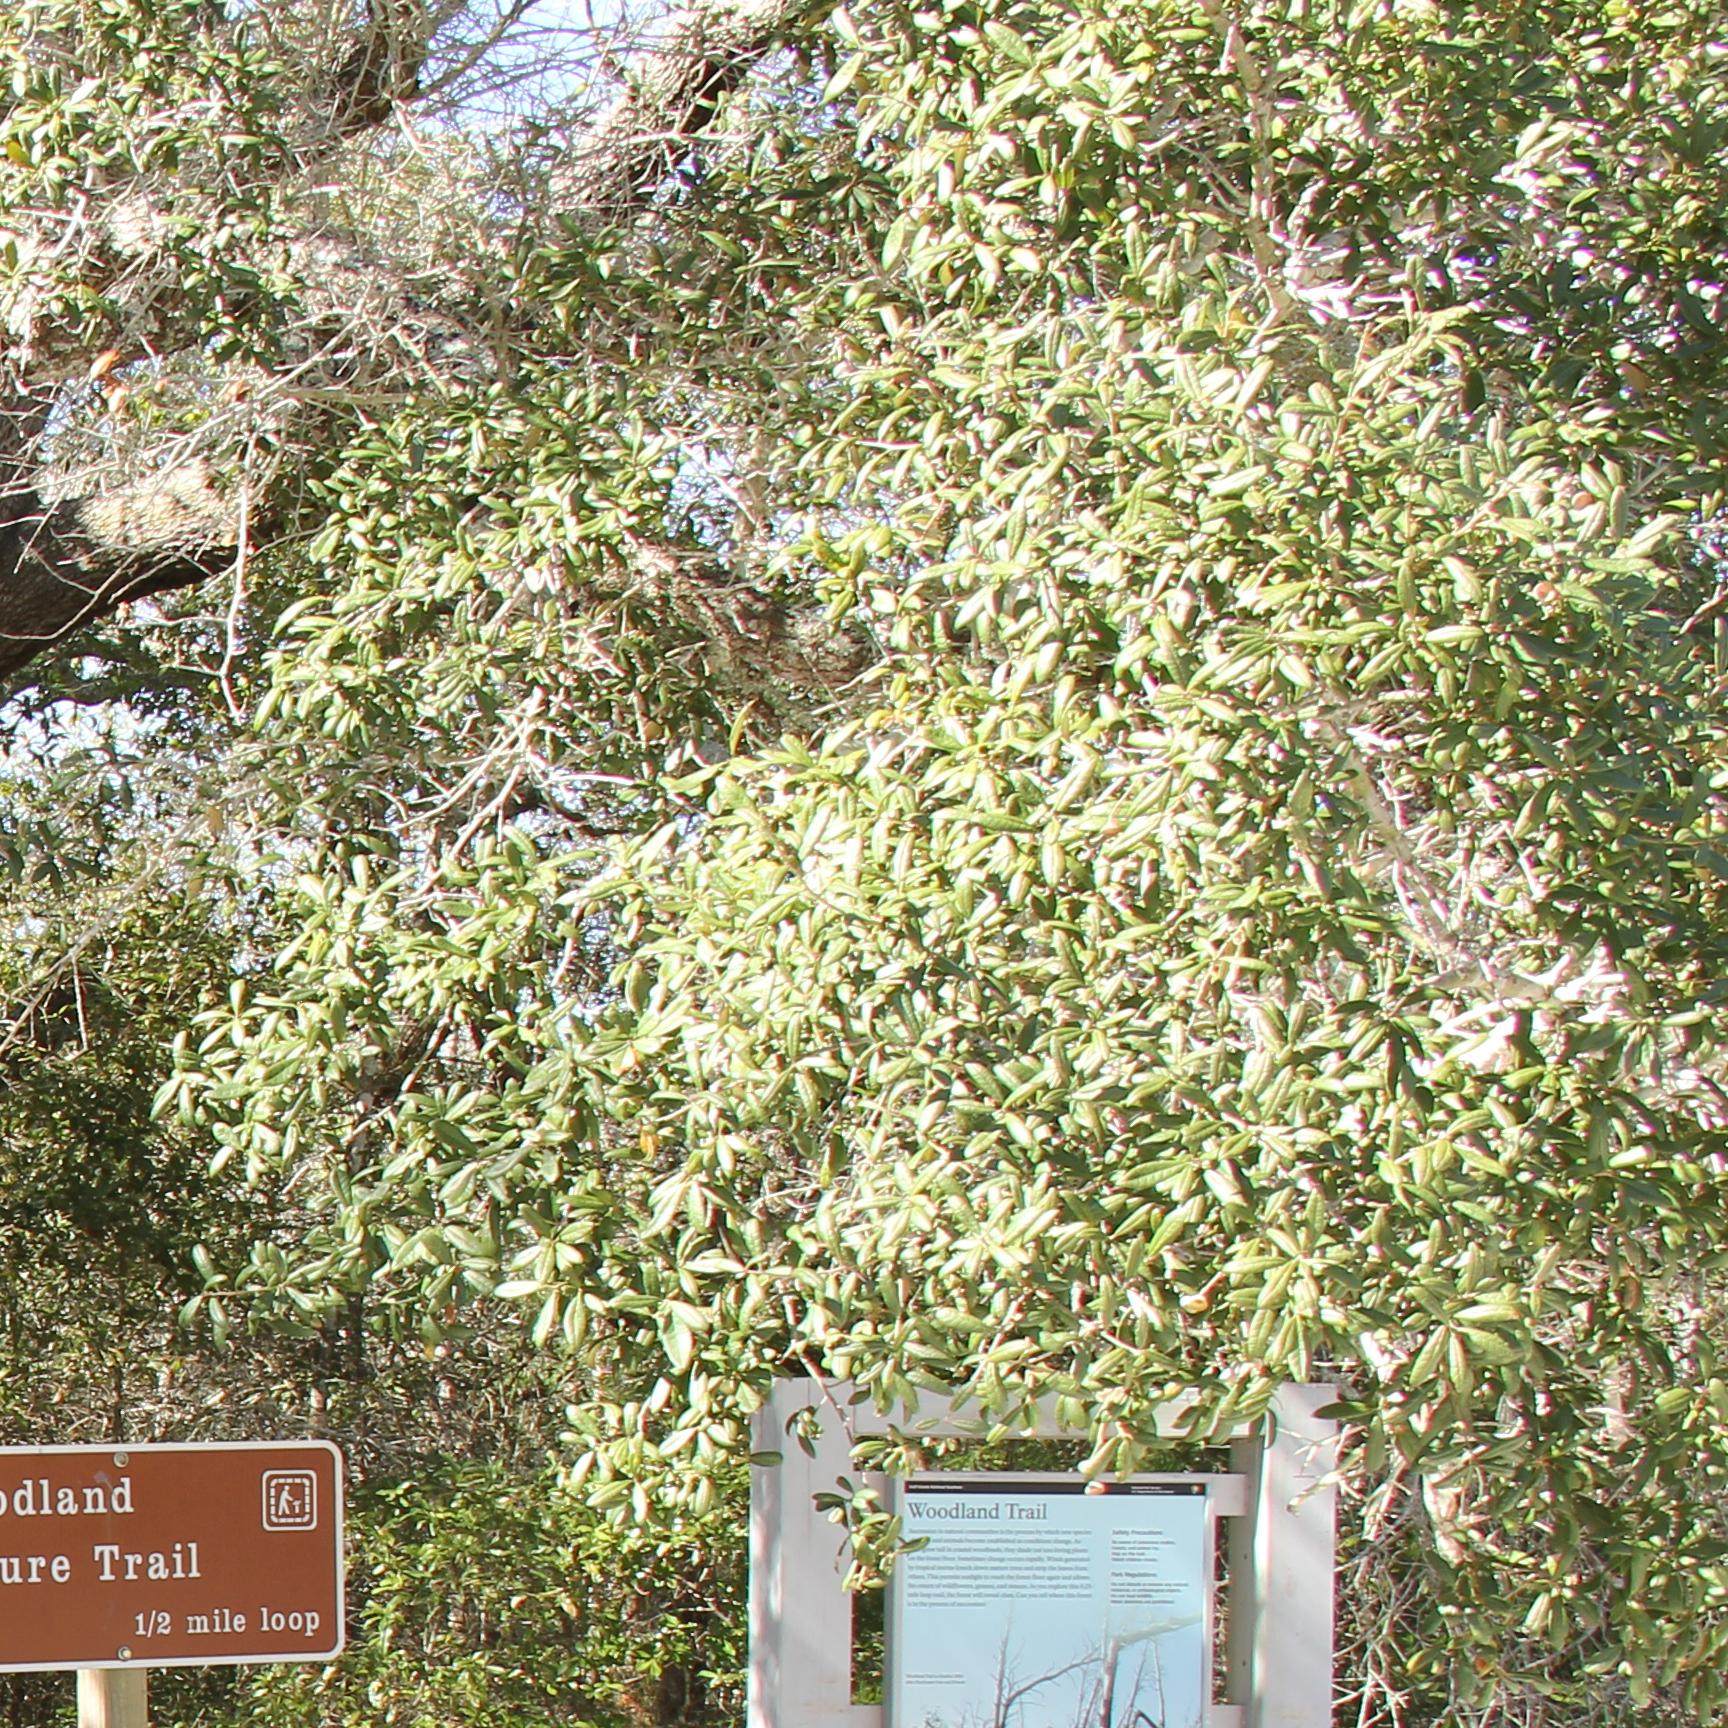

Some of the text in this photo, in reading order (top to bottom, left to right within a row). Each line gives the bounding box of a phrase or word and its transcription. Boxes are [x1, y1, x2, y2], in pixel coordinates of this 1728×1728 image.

[907, 1502, 1047, 1520] Woodland Trail
[93, 1542, 202, 1581] Trail
[134, 1606, 320, 1638] 1/2 mile loop
